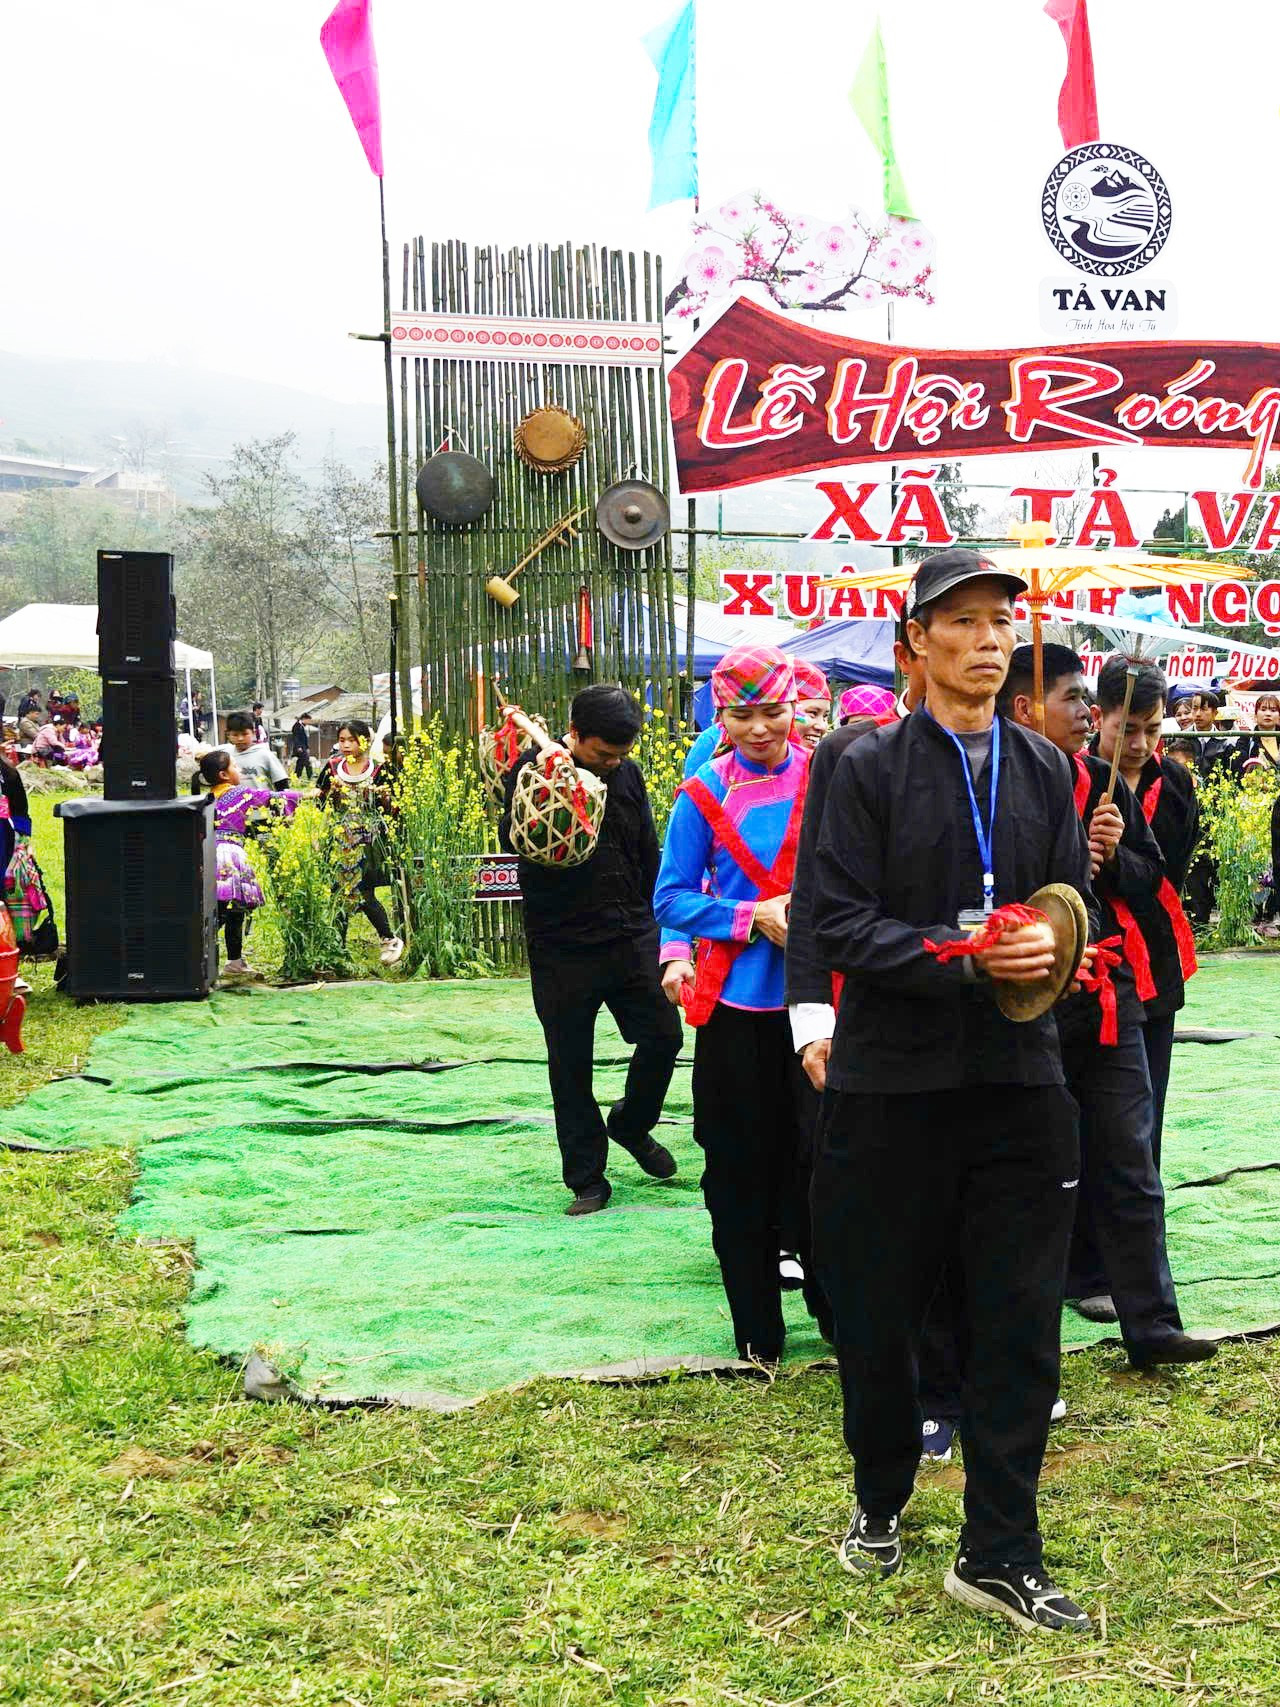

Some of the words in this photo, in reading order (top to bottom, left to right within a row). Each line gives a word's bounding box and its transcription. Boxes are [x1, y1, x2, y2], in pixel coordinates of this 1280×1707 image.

[1052, 283, 1096, 310] TẢ
[1100, 289, 1166, 311] VAN
[698, 357, 825, 449] Lễ
[825, 356, 991, 452] Hội
[809, 467, 956, 544] XÃ
[1009, 467, 1141, 547] TẢ
[1168, 647, 1215, 677] năm
